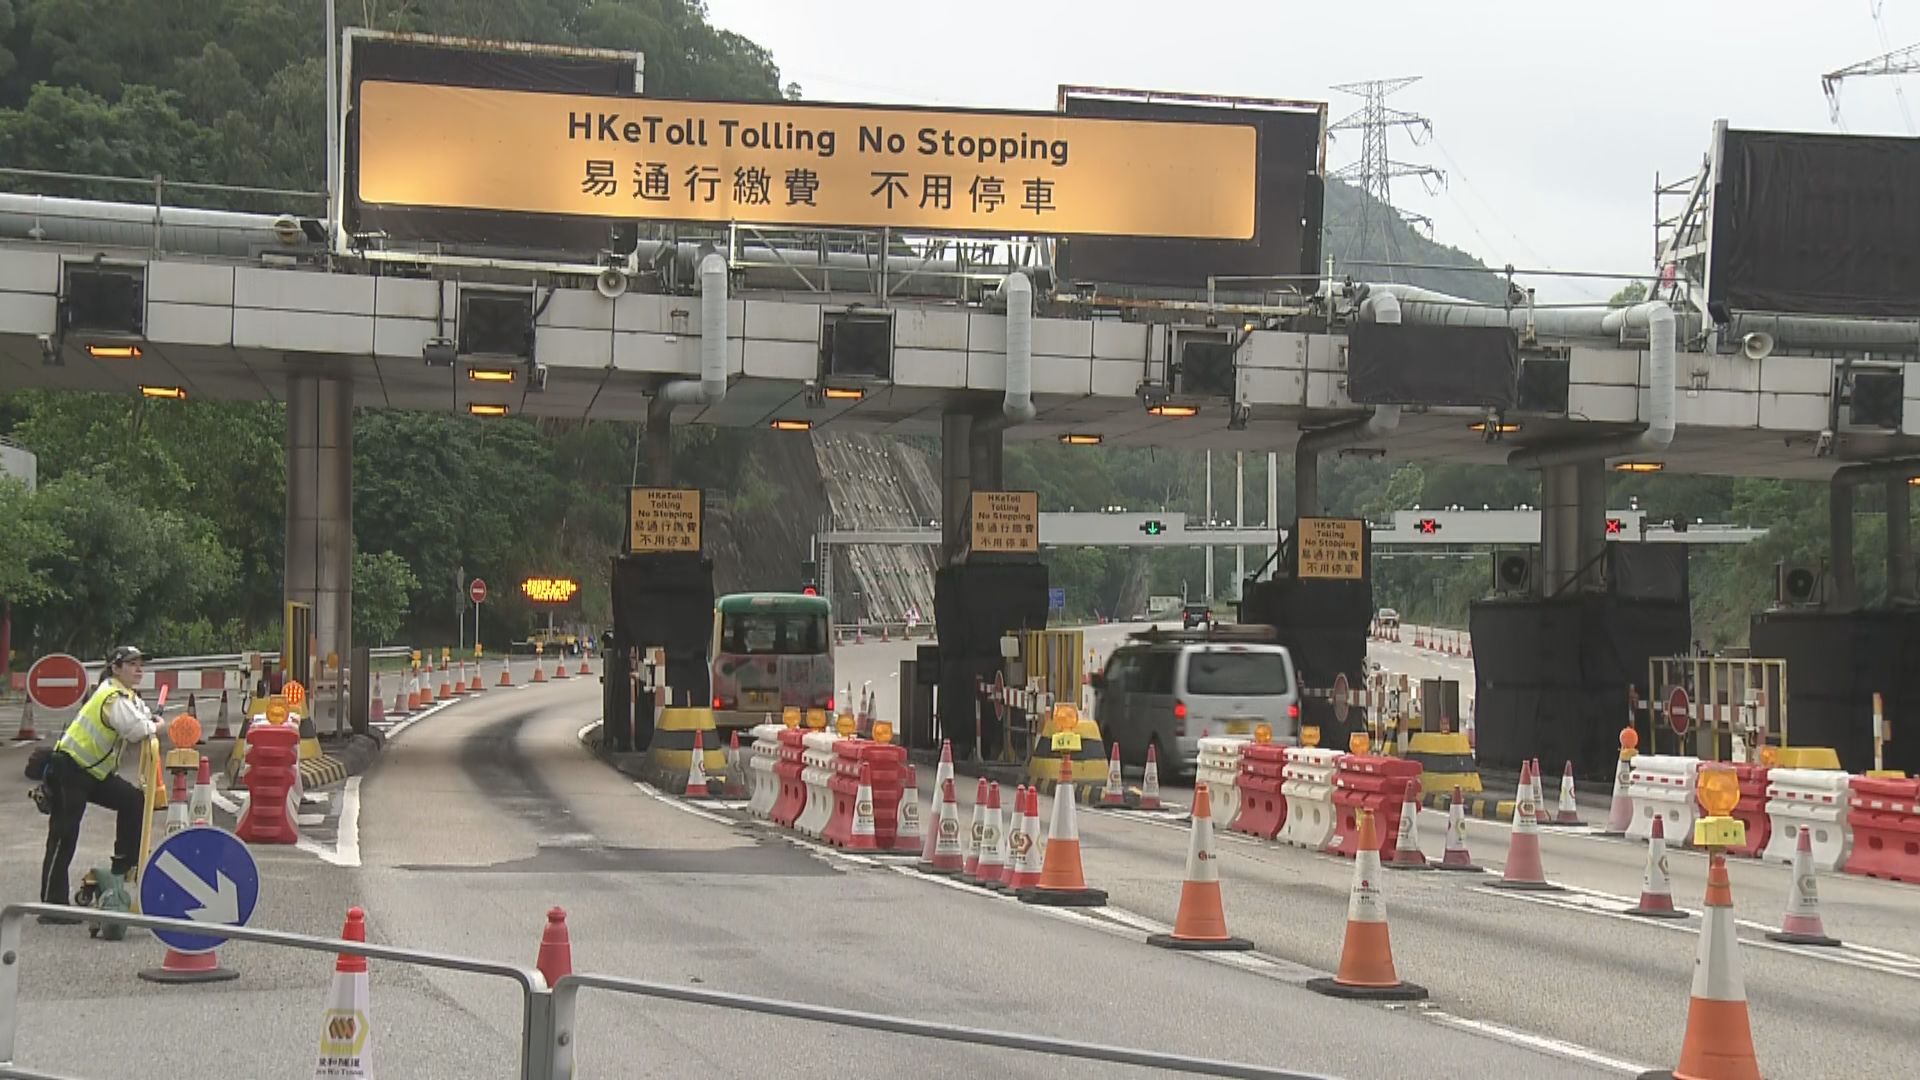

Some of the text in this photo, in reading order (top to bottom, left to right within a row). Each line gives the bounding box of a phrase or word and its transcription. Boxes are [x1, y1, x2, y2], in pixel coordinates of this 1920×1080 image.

[568, 112, 1069, 168] HKeToll Tolling No Stopping
[581, 159, 1057, 216] 易通行繳費 不用停車
